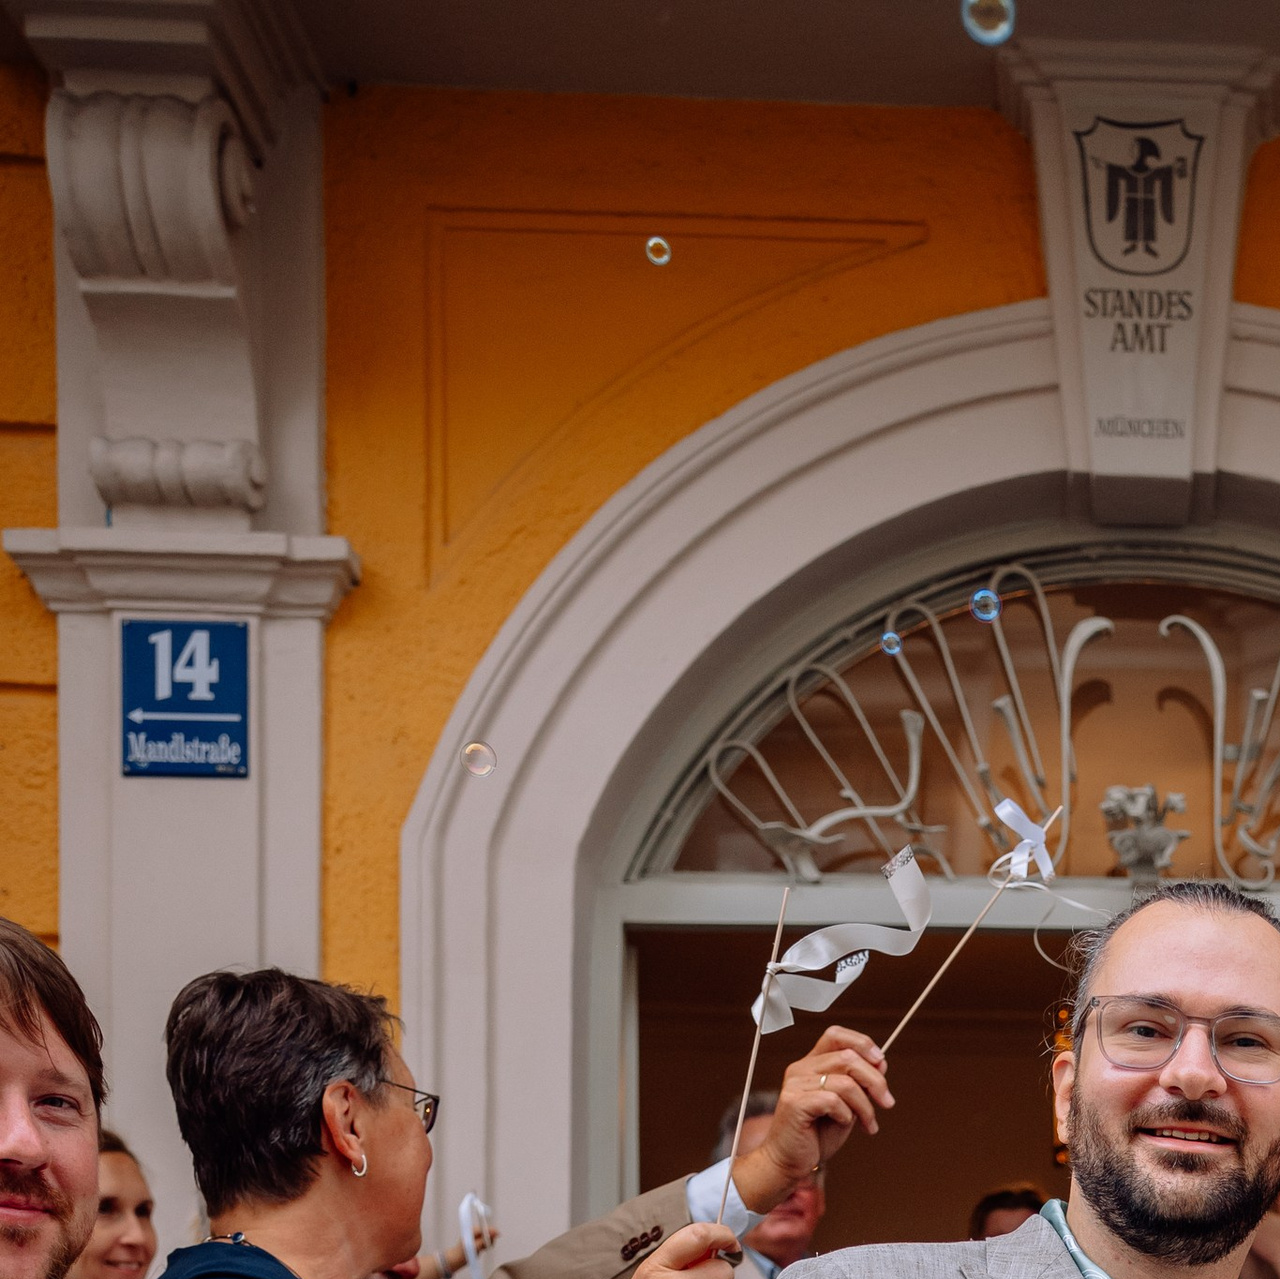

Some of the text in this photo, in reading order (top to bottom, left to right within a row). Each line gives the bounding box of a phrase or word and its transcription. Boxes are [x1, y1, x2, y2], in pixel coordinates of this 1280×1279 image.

[1084, 287, 1194, 321] STANDES
[1110, 322, 1173, 354] AMT
[148, 628, 220, 701] 14
[127, 731, 242, 765] Mandlstraße
